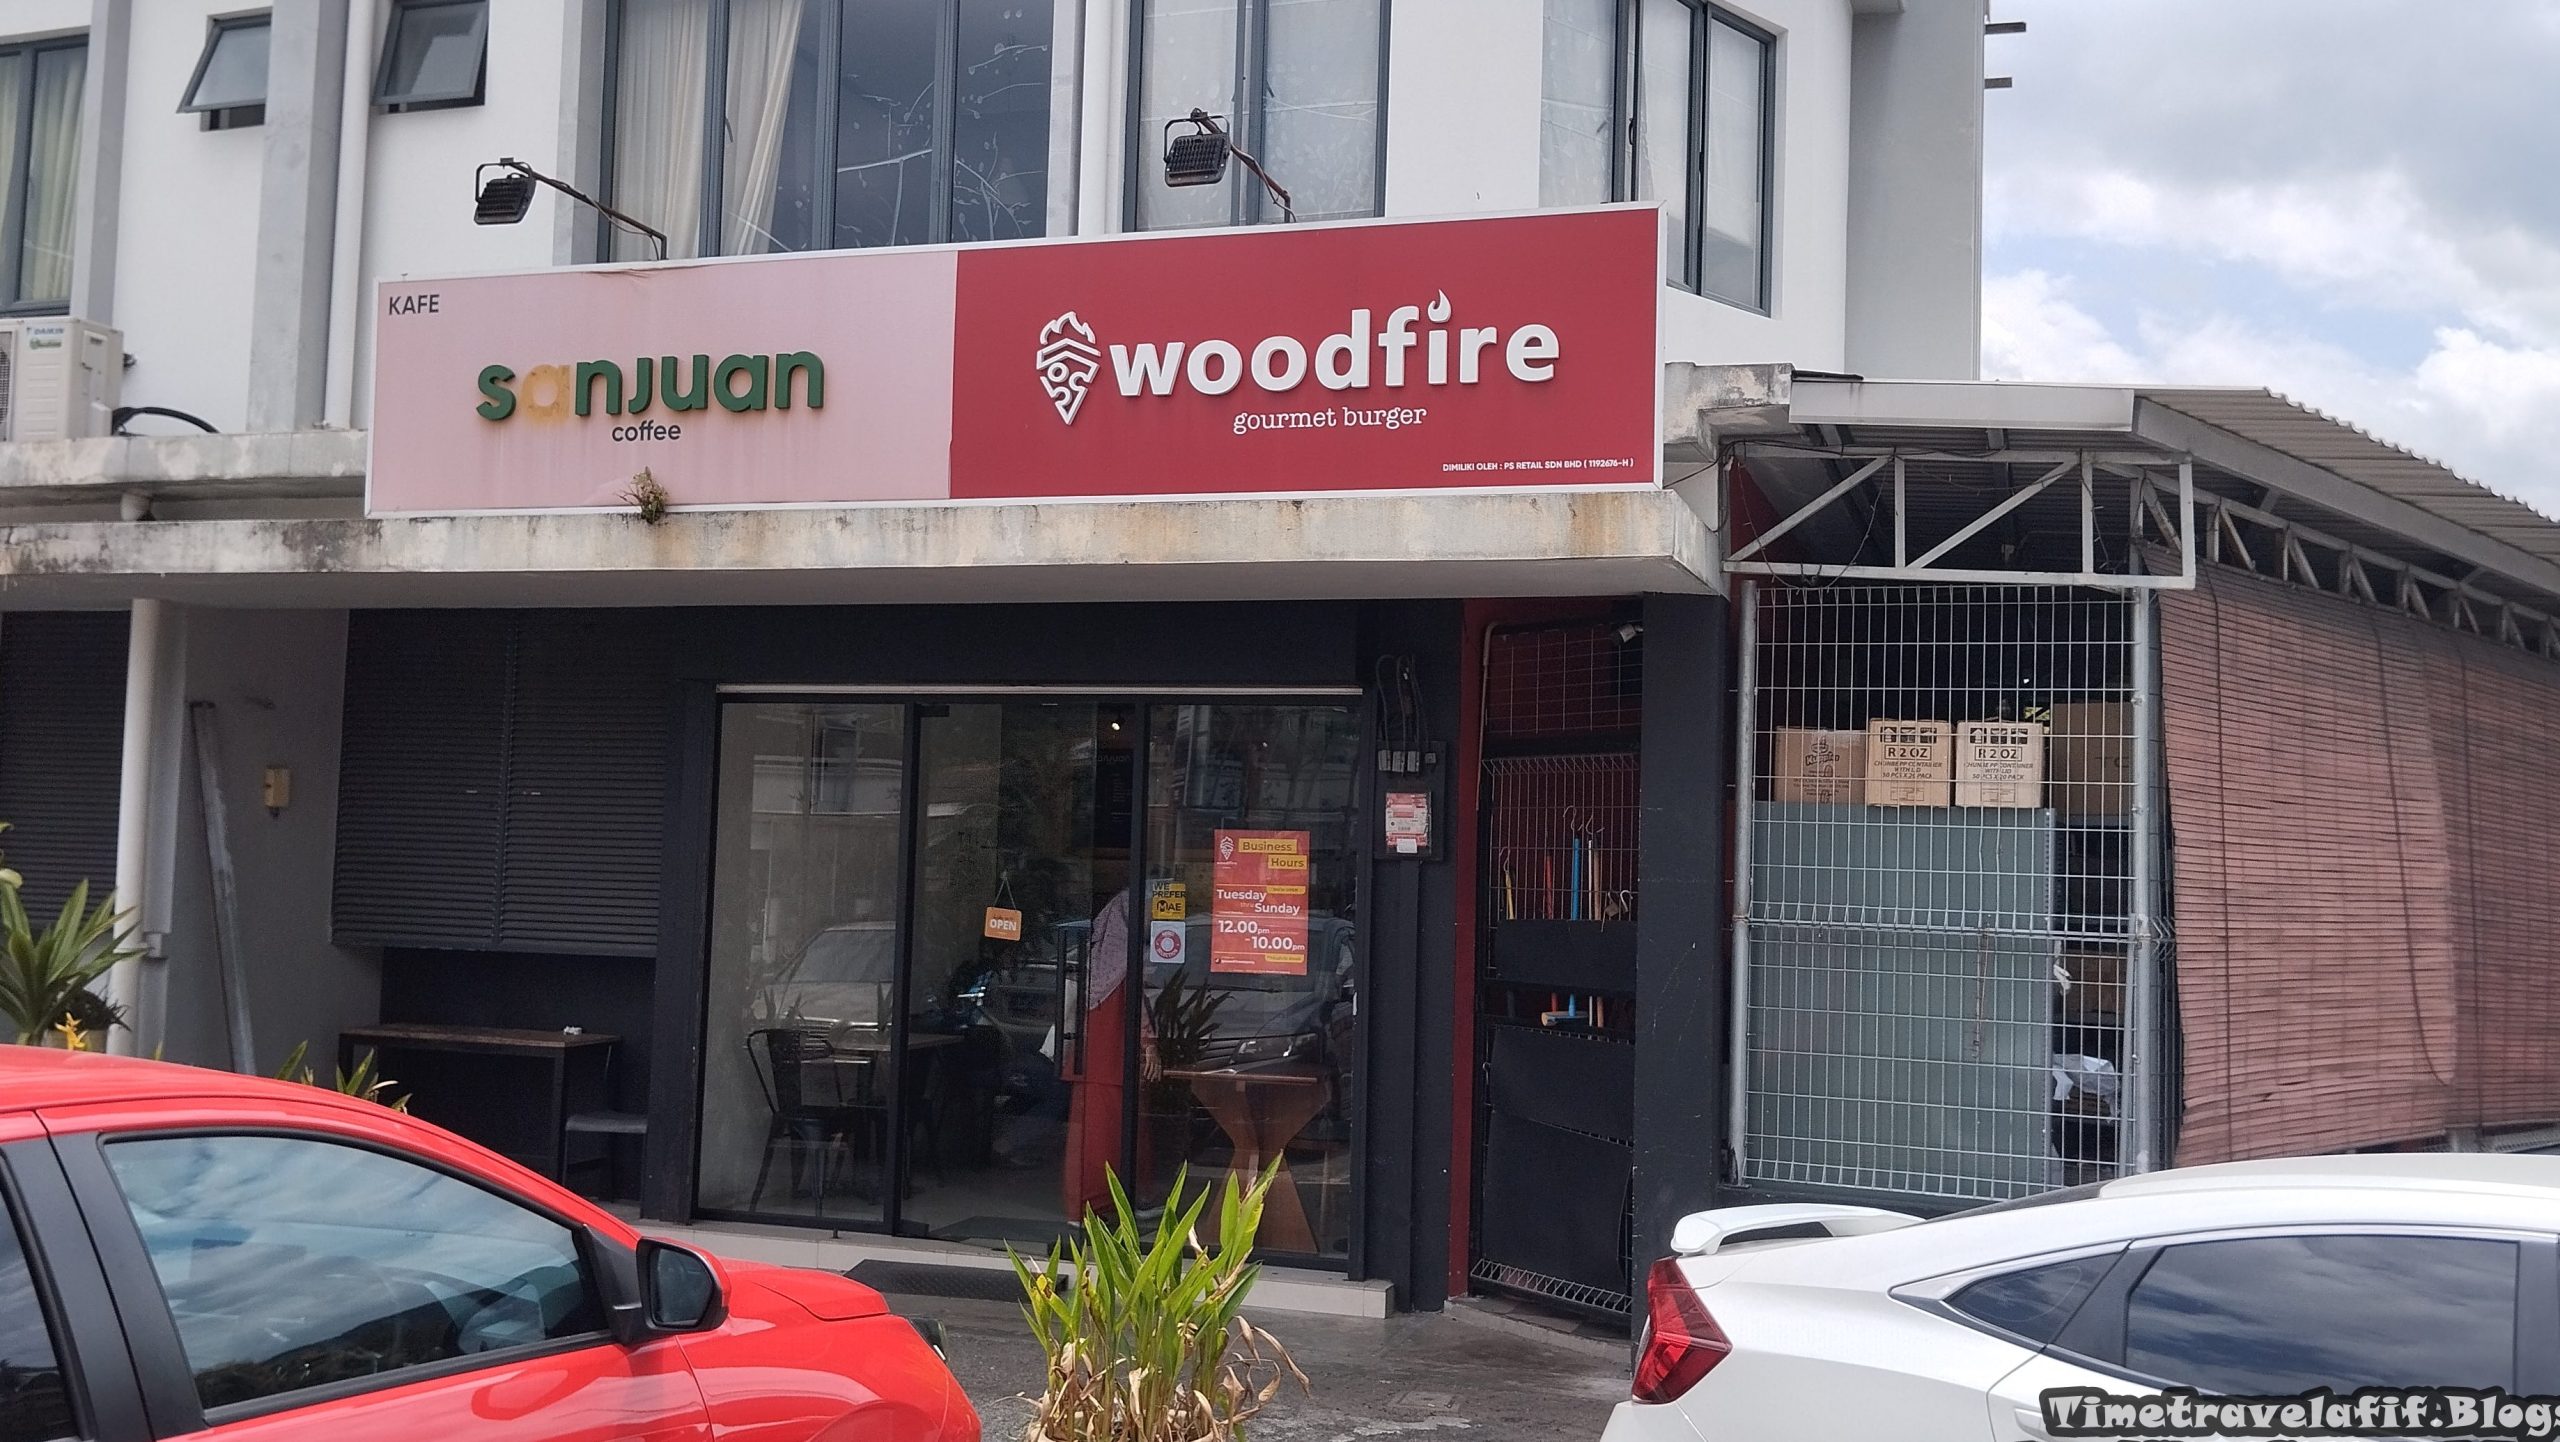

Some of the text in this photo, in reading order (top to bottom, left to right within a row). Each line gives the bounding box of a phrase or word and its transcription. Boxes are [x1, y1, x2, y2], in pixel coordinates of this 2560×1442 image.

[389, 294, 440, 315] KAFE
[1109, 289, 1560, 397] woodfire
[1232, 406, 1427, 435] gourmet burger
[611, 420, 682, 442] coffee
[1443, 463, 1475, 472] DIMILIKI
[1476, 462, 1498, 471] OLEH
[1503, 462, 1515, 470] PS
[1516, 461, 1543, 470] RETAIL
[1544, 460, 1562, 469] SDN
[1564, 460, 1582, 468] BHD
[1888, 747, 1928, 758] R 2 OZ
[1989, 748, 1997, 758] 2
[2000, 748, 2018, 759] OZ
[1242, 841, 1293, 851] Business
[1271, 858, 1305, 867] Hours
[1153, 881, 1170, 891] WE
[1152, 890, 1186, 898] PREFER
[1216, 889, 1267, 902] Tuesday
[1157, 900, 1181, 912] MAE
[1254, 903, 1300, 916] Sunday
[990, 919, 1017, 931] OPEN
